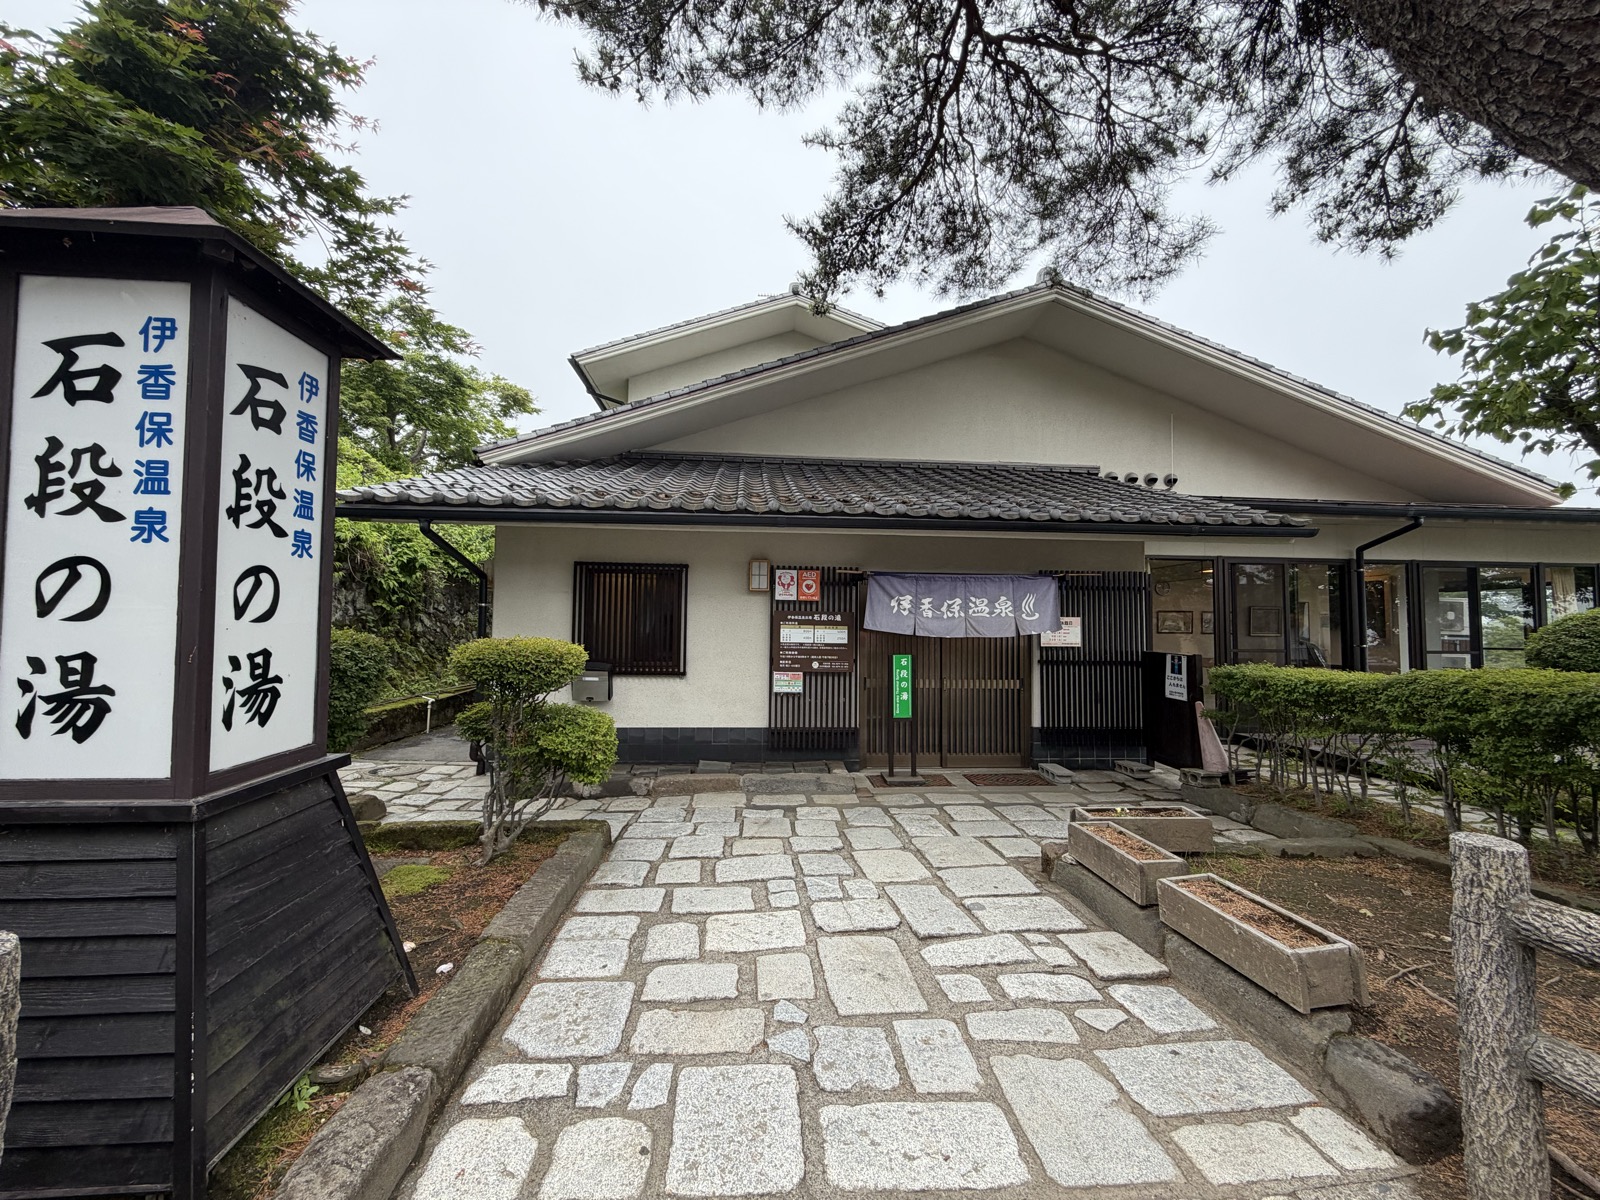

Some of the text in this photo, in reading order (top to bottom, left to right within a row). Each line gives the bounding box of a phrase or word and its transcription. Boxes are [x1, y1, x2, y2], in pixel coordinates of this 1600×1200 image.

[130, 315, 178, 544] 伊香保温泉
[291, 371, 320, 560] 伊香保温泉
[15, 331, 127, 744] 石段の湯
[221, 363, 289, 732] 石段の湯
[890, 594, 1015, 620] 伊香保温泉
[900, 658, 908, 701] 石段の湯
[1166, 674, 1184, 682] ここからは
[1168, 681, 1186, 690] 入れません
